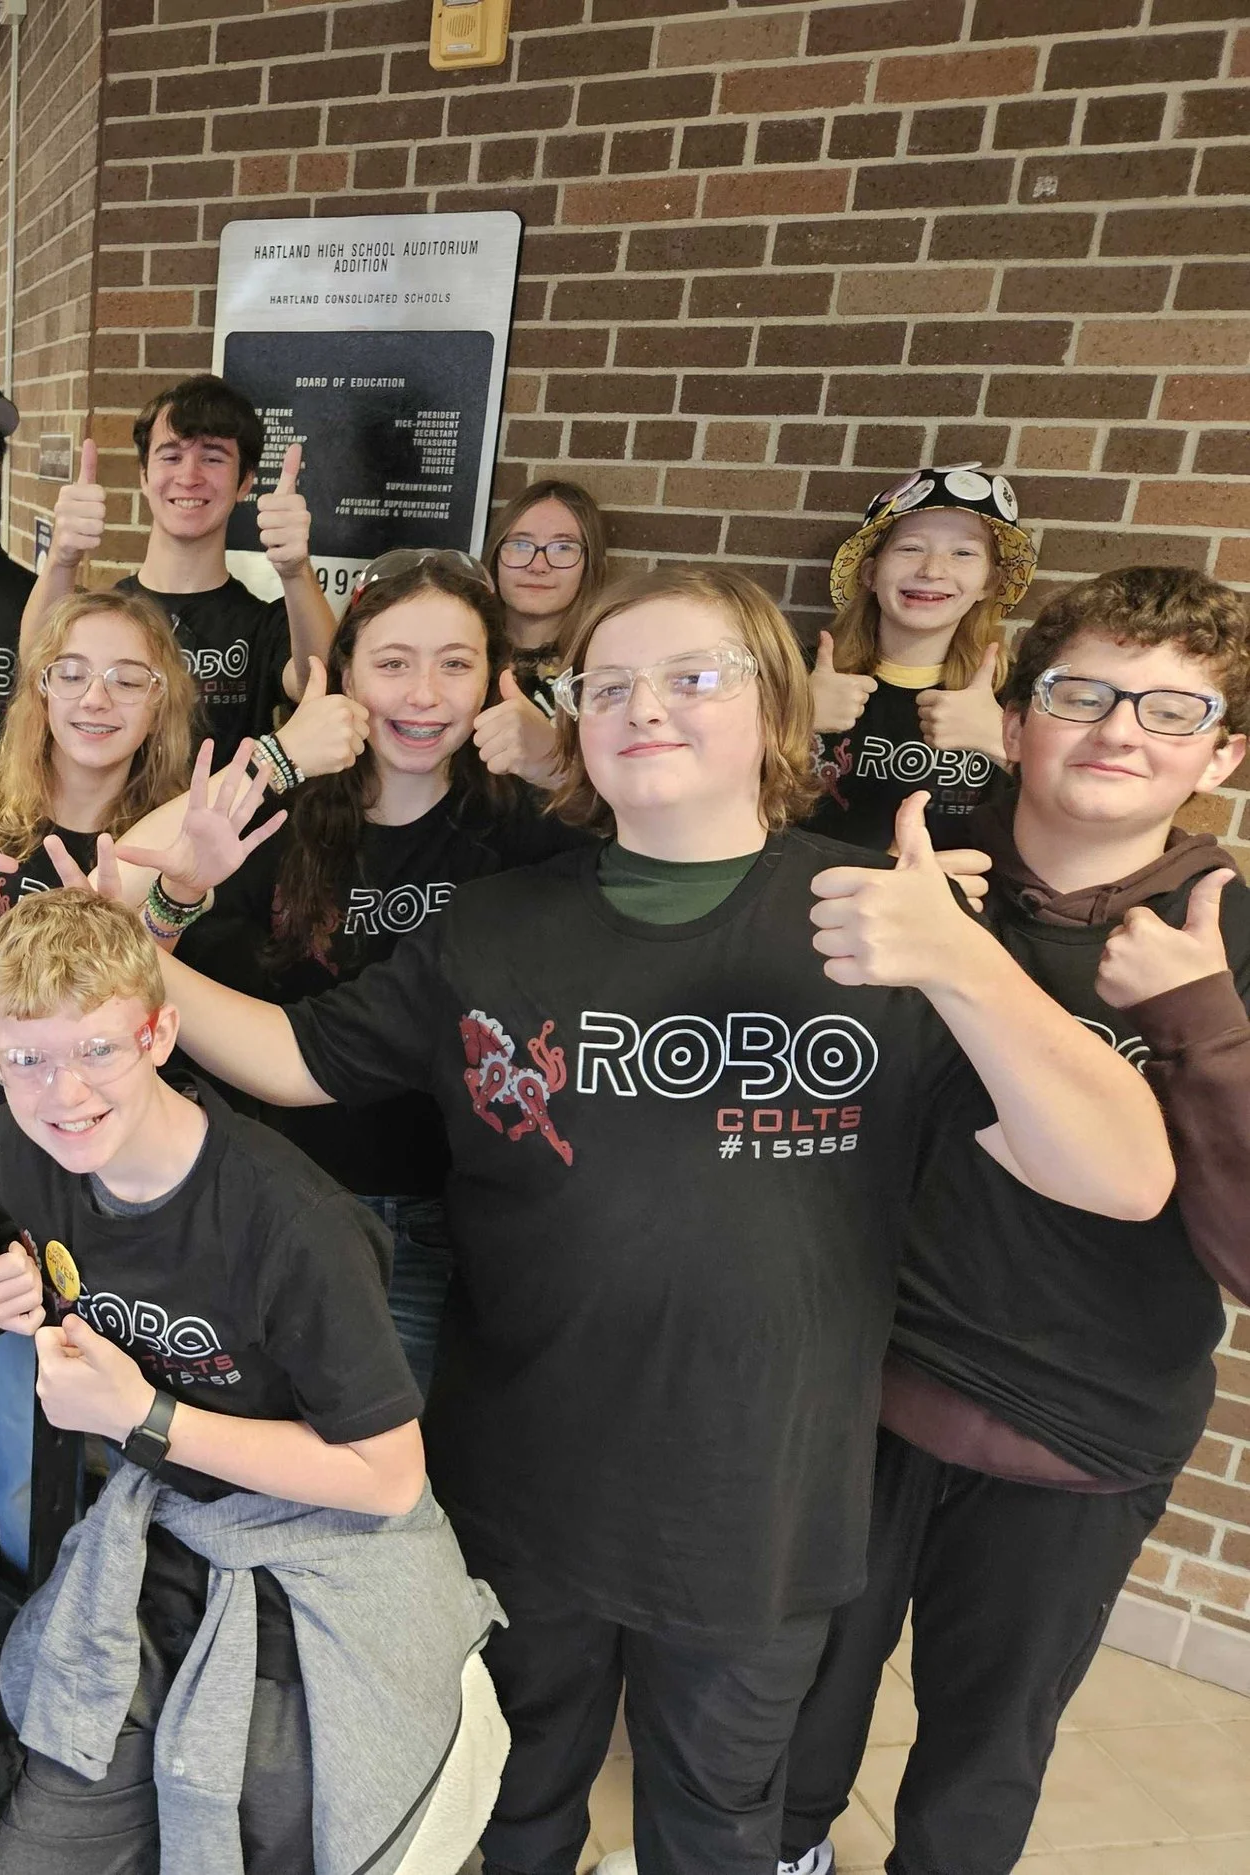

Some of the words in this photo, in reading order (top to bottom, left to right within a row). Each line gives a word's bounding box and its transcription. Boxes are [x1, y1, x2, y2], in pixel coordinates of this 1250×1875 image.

[254, 244, 311, 260] HARTLAND
[317, 243, 345, 258] HIGH
[351, 241, 396, 257] SCHOOL
[403, 240, 479, 256] AUDITORIUM
[333, 258, 388, 273] ADDITION
[269, 294, 319, 305] HARTLAND
[325, 293, 398, 304] CONSOLIDATED
[404, 292, 452, 303] SCHOOLS
[295, 377, 327, 389] BOARD
[332, 377, 346, 388] OF
[350, 377, 406, 389] EDUCATION
[265, 408, 294, 417] GREENE
[417, 411, 461, 420] PRESIDENT
[394, 419, 460, 429] VICE-PRESIDENT
[266, 426, 295, 434] BUTLER
[414, 429, 459, 438] SECRETARY
[412, 438, 458, 447] TREASURER
[422, 447, 456, 457] TRUSTEE
[421, 456, 456, 466] TRUSTEE
[420, 465, 455, 475] TRUSTEE
[385, 482, 453, 493] SUPERINTENDENT
[340, 498, 381, 507] ASSISTANT
[383, 499, 451, 511] SUPERINTENDENT
[335, 506, 351, 515] FOR
[353, 507, 390, 517] BUSINESS
[392, 509, 400, 518] &
[402, 510, 450, 520] OPERATIONS
[856, 735, 996, 788] ROBO
[577, 1010, 879, 1100] ROBO
[716, 1104, 862, 1132] COLTS
[718, 1133, 859, 1160] #15358
